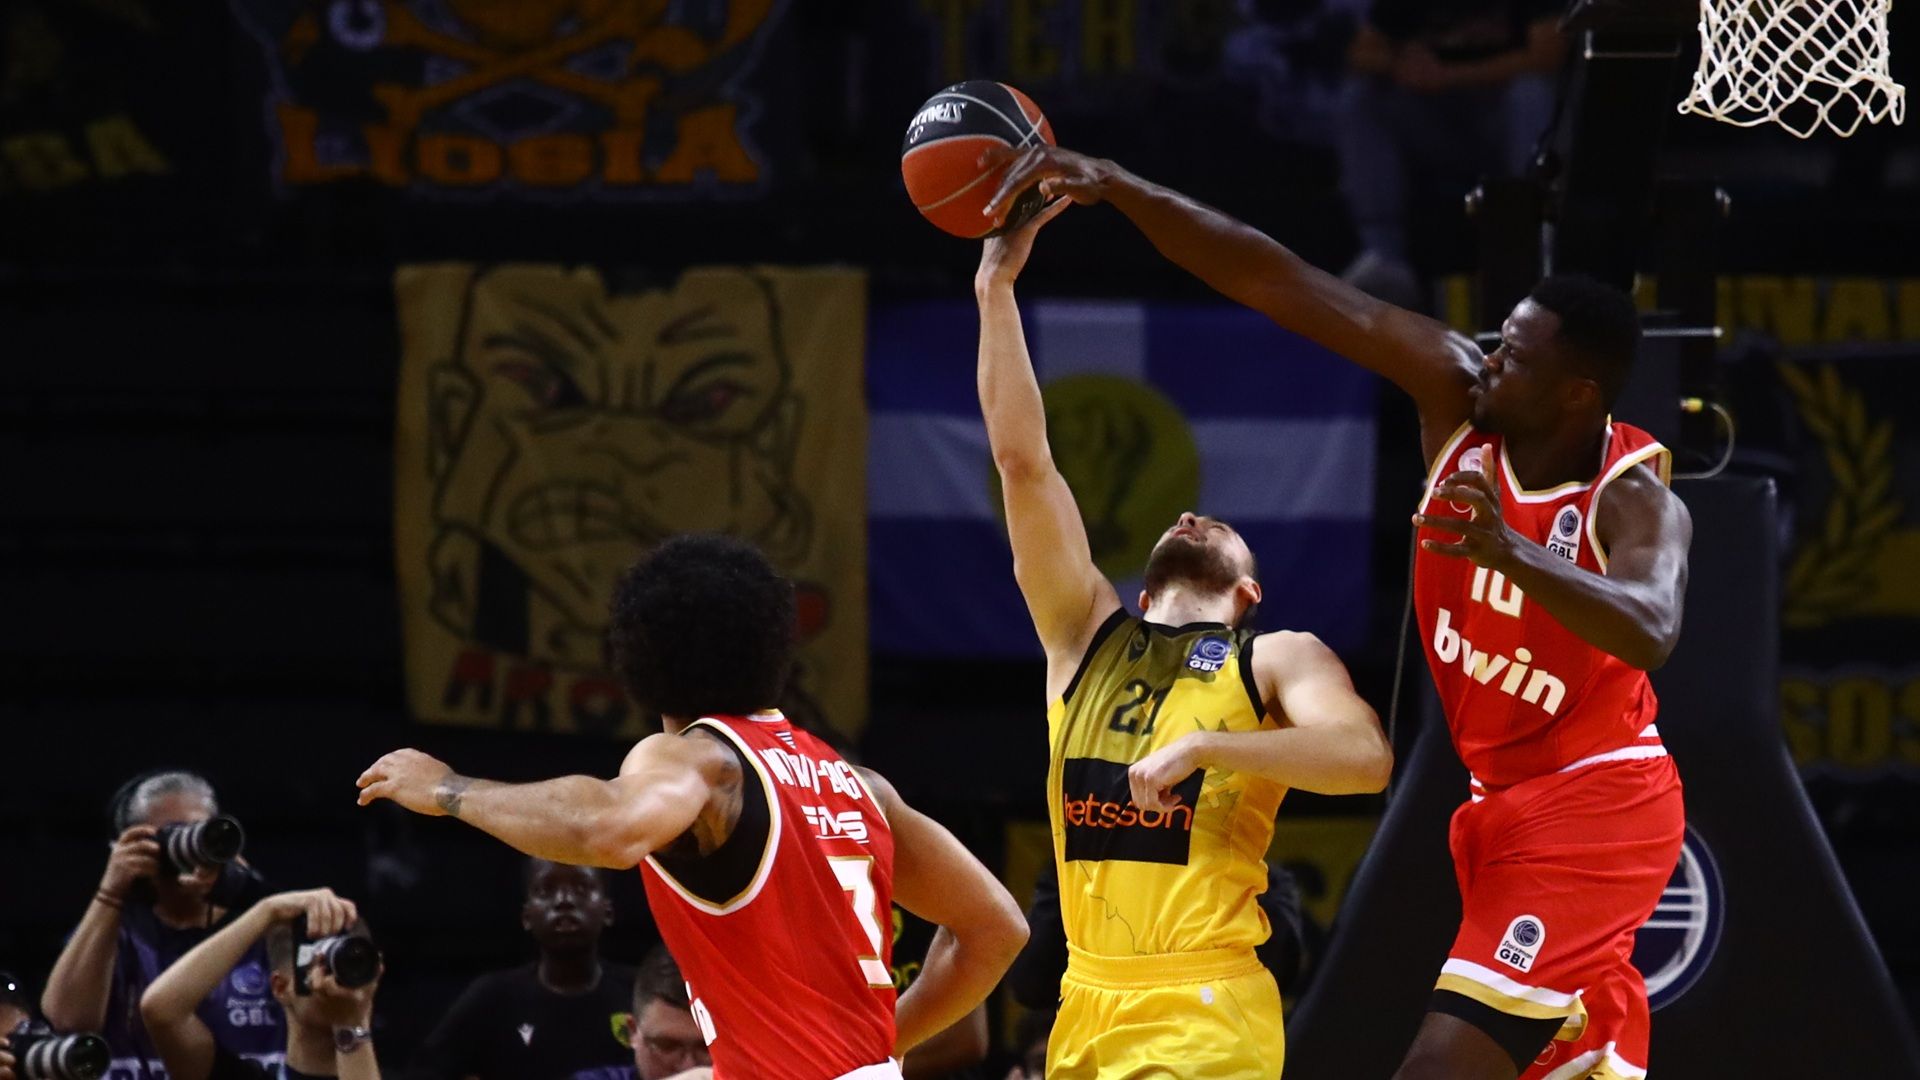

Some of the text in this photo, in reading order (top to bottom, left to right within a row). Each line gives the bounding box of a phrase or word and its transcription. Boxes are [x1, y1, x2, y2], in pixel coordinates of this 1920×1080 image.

[1548, 543, 1574, 561] GBL
[1189, 659, 1219, 672] GBL
[1433, 607, 1567, 716] bwin
[1108, 677, 1172, 737] 21
[1499, 948, 1527, 970] GBL
